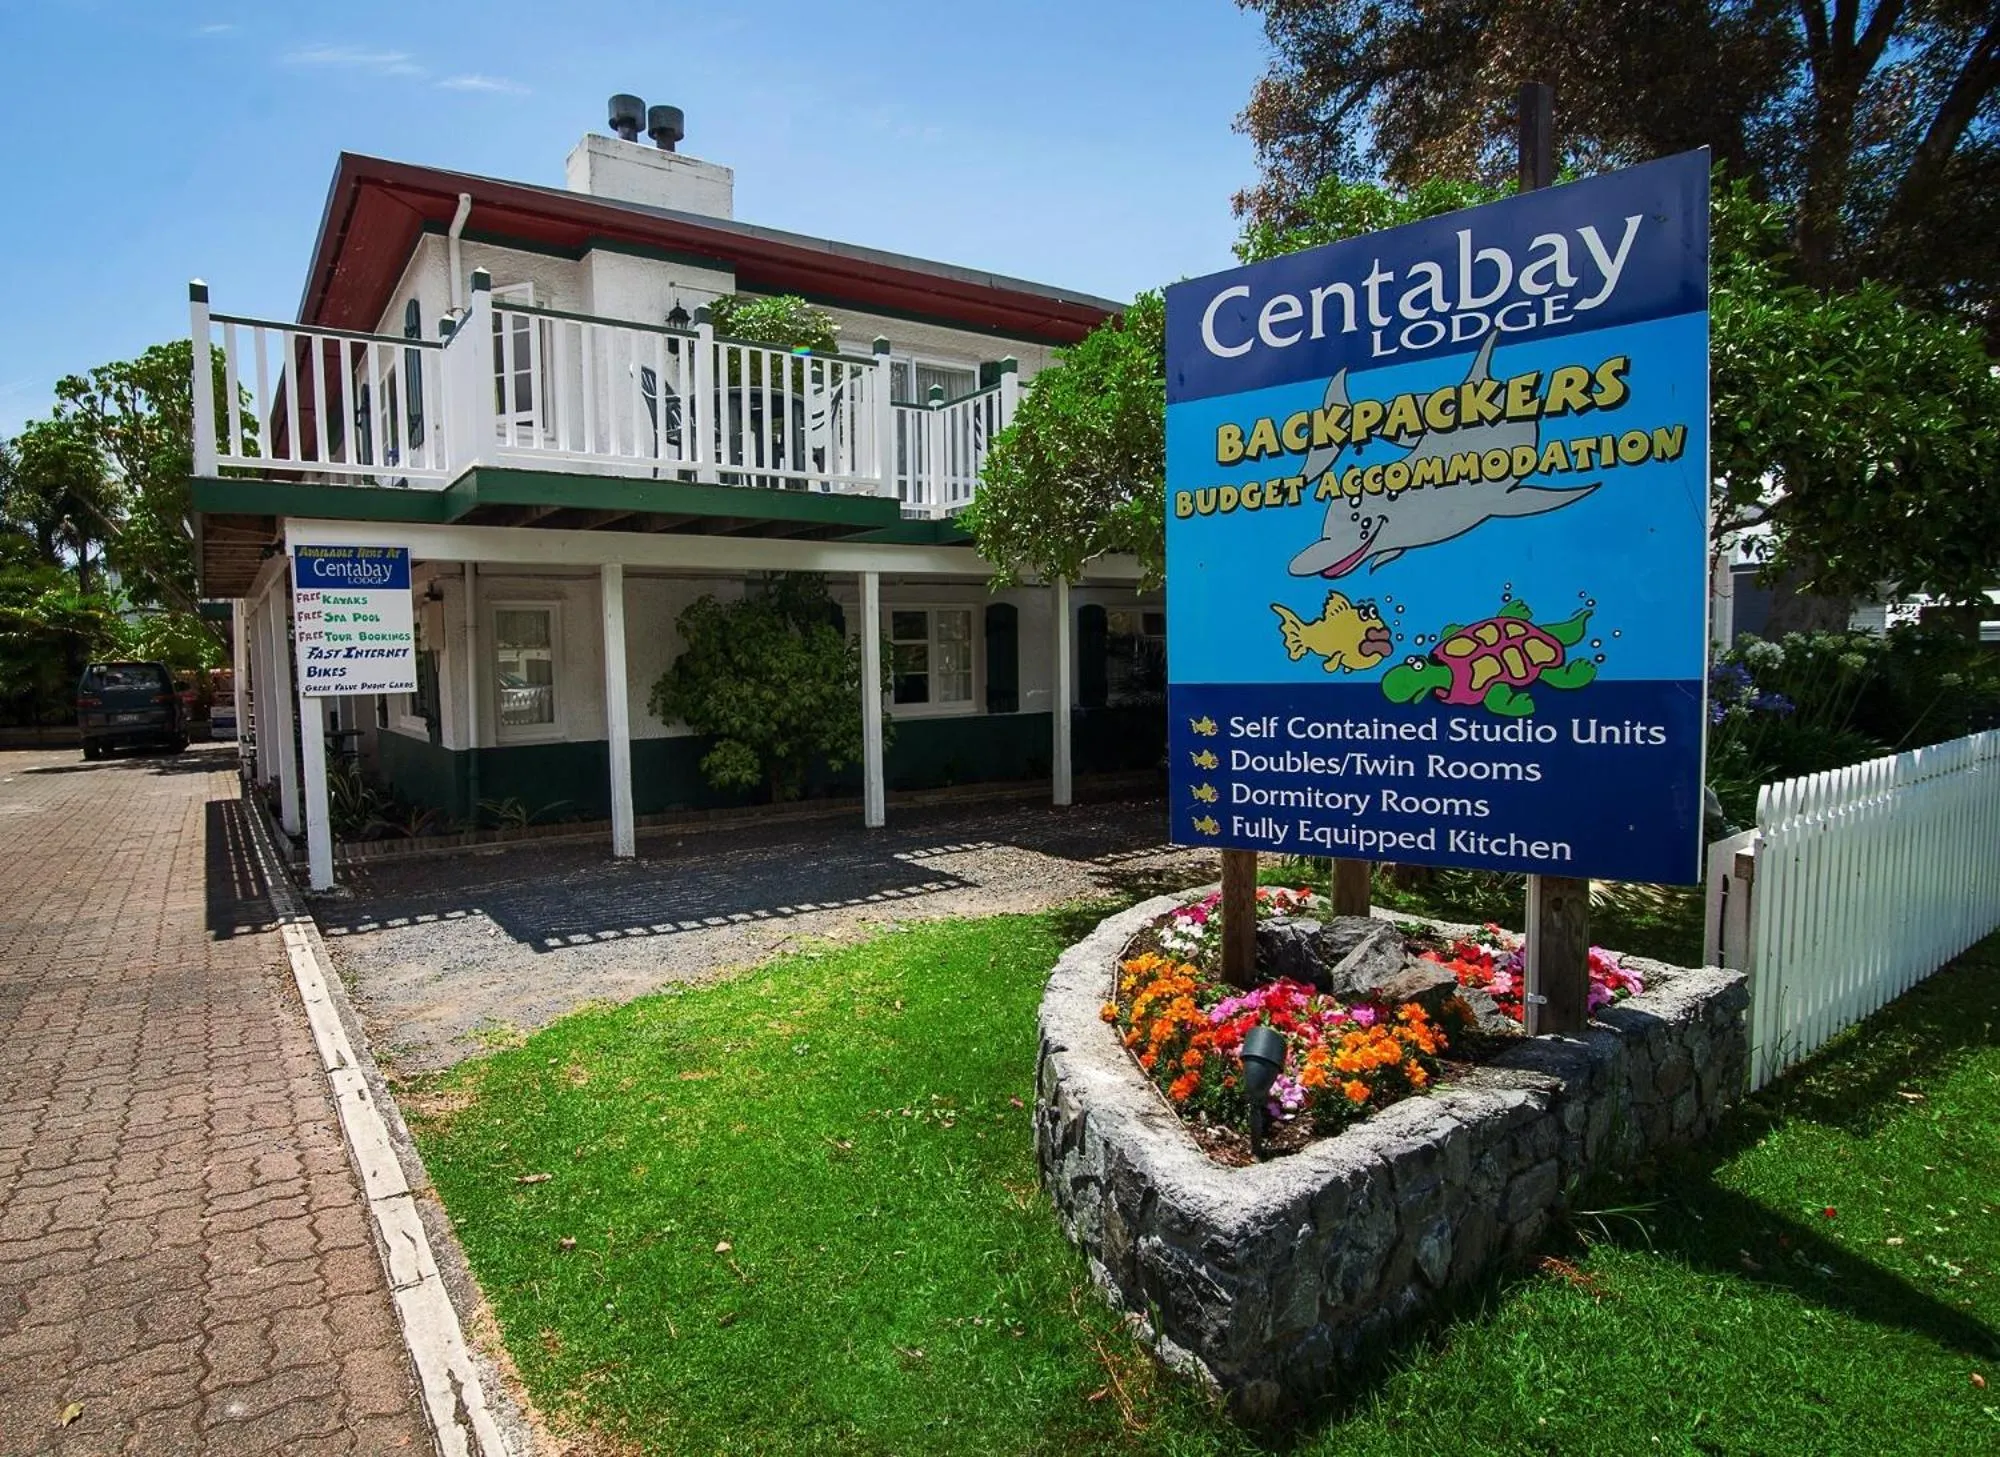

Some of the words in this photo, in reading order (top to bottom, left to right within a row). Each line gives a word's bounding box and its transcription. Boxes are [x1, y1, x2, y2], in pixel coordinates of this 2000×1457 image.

[1200, 214, 1644, 359] Centabay
[1370, 293, 1574, 358] LODGE
[1216, 355, 1631, 465] BACKPACKERS
[1175, 475, 1305, 519] BUDGET
[1315, 424, 1688, 501] ACCOMMODATION
[313, 558, 393, 582] Centabay
[347, 576, 384, 584] LODGE
[296, 592, 321, 604] FREE
[322, 595, 368, 604] KAYAKS
[297, 610, 322, 622] FREE
[324, 612, 347, 623] SPA
[353, 612, 380, 622] POOL
[298, 630, 323, 642] FREE
[324, 631, 353, 642] TOUR
[359, 631, 411, 641] BOOKINGS
[306, 646, 343, 660] FAST
[343, 646, 409, 660] INTERNET
[306, 666, 347, 678] BIKES
[1229, 716, 1279, 740] Self
[1286, 716, 1438, 741] Contained
[1448, 717, 1558, 743] Studio
[1571, 718, 1667, 745] Units
[1231, 749, 1415, 777] Doubles/Twin
[1427, 755, 1542, 782] Rooms
[1232, 783, 1371, 816] Dormitory
[1381, 790, 1490, 818] Rooms
[1232, 816, 1289, 845] Fully
[1299, 820, 1436, 853] Equipped
[1449, 829, 1572, 861] Kitchen
